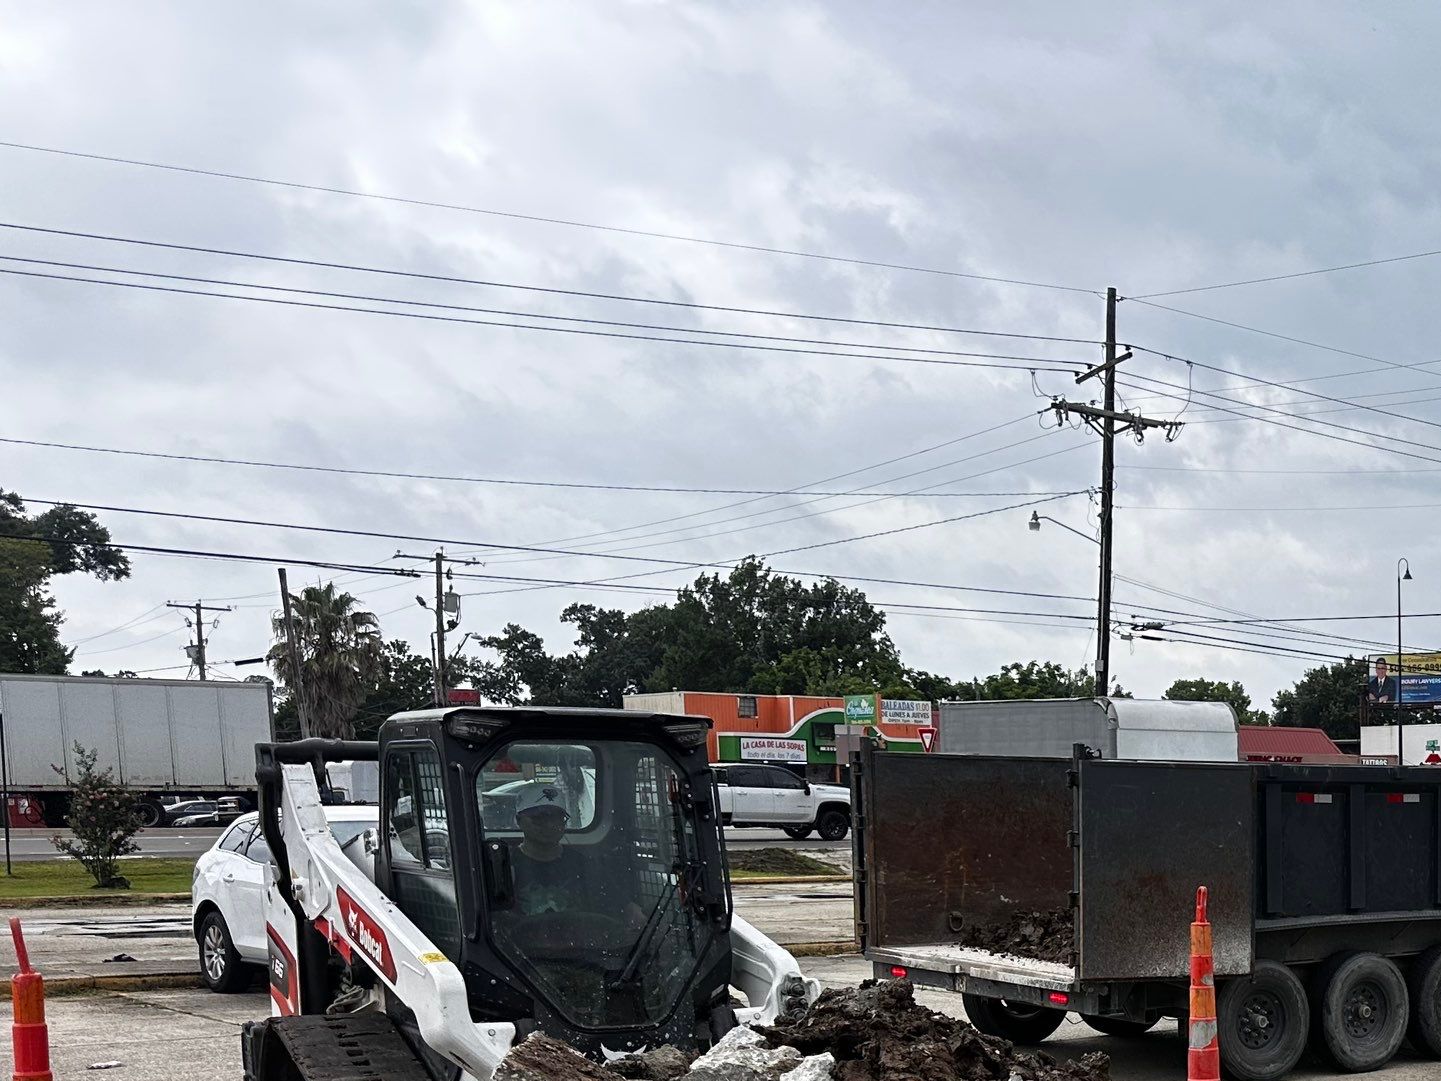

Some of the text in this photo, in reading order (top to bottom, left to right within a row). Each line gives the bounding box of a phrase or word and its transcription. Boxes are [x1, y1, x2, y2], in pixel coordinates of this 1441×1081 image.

[881, 701, 915, 711] BALEADAS
[742, 740, 805, 752] LA CASA DE LAS SOPAS
[359, 920, 384, 967] Bobcat
